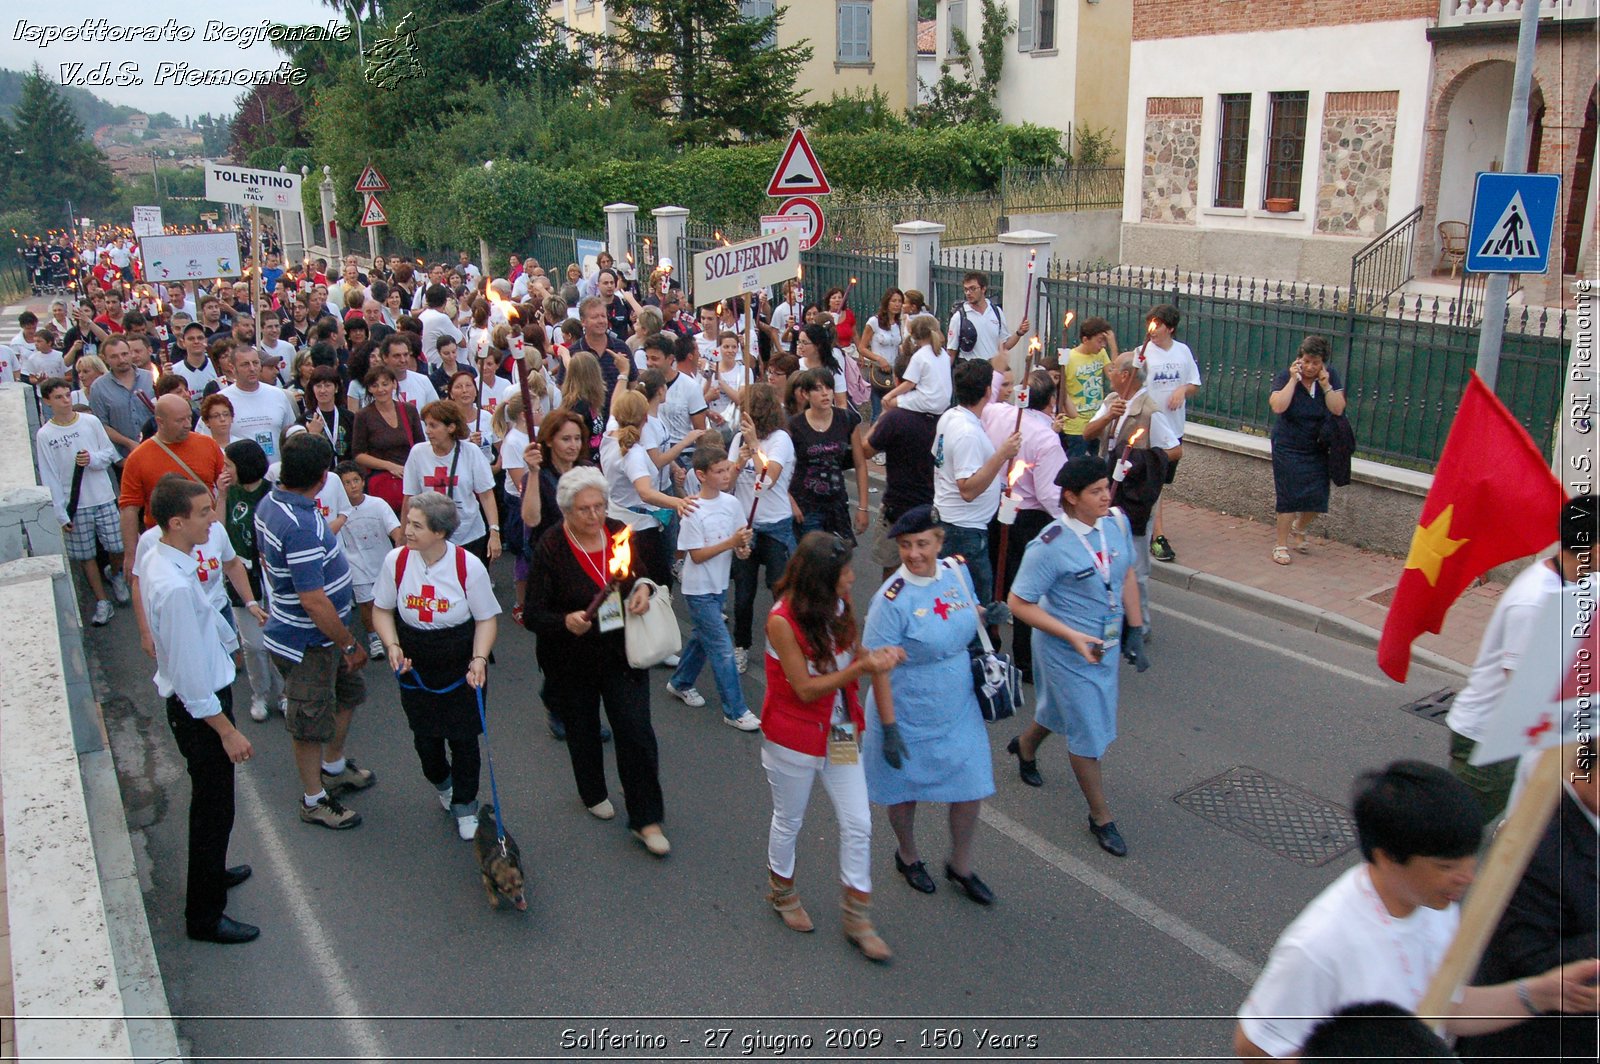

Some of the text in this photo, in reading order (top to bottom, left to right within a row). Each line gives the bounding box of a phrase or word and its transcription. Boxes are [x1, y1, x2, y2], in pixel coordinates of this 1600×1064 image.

[213, 170, 293, 189] TOLENTINO
[243, 193, 264, 201] ITALY
[704, 236, 790, 282] SOLFERINO
